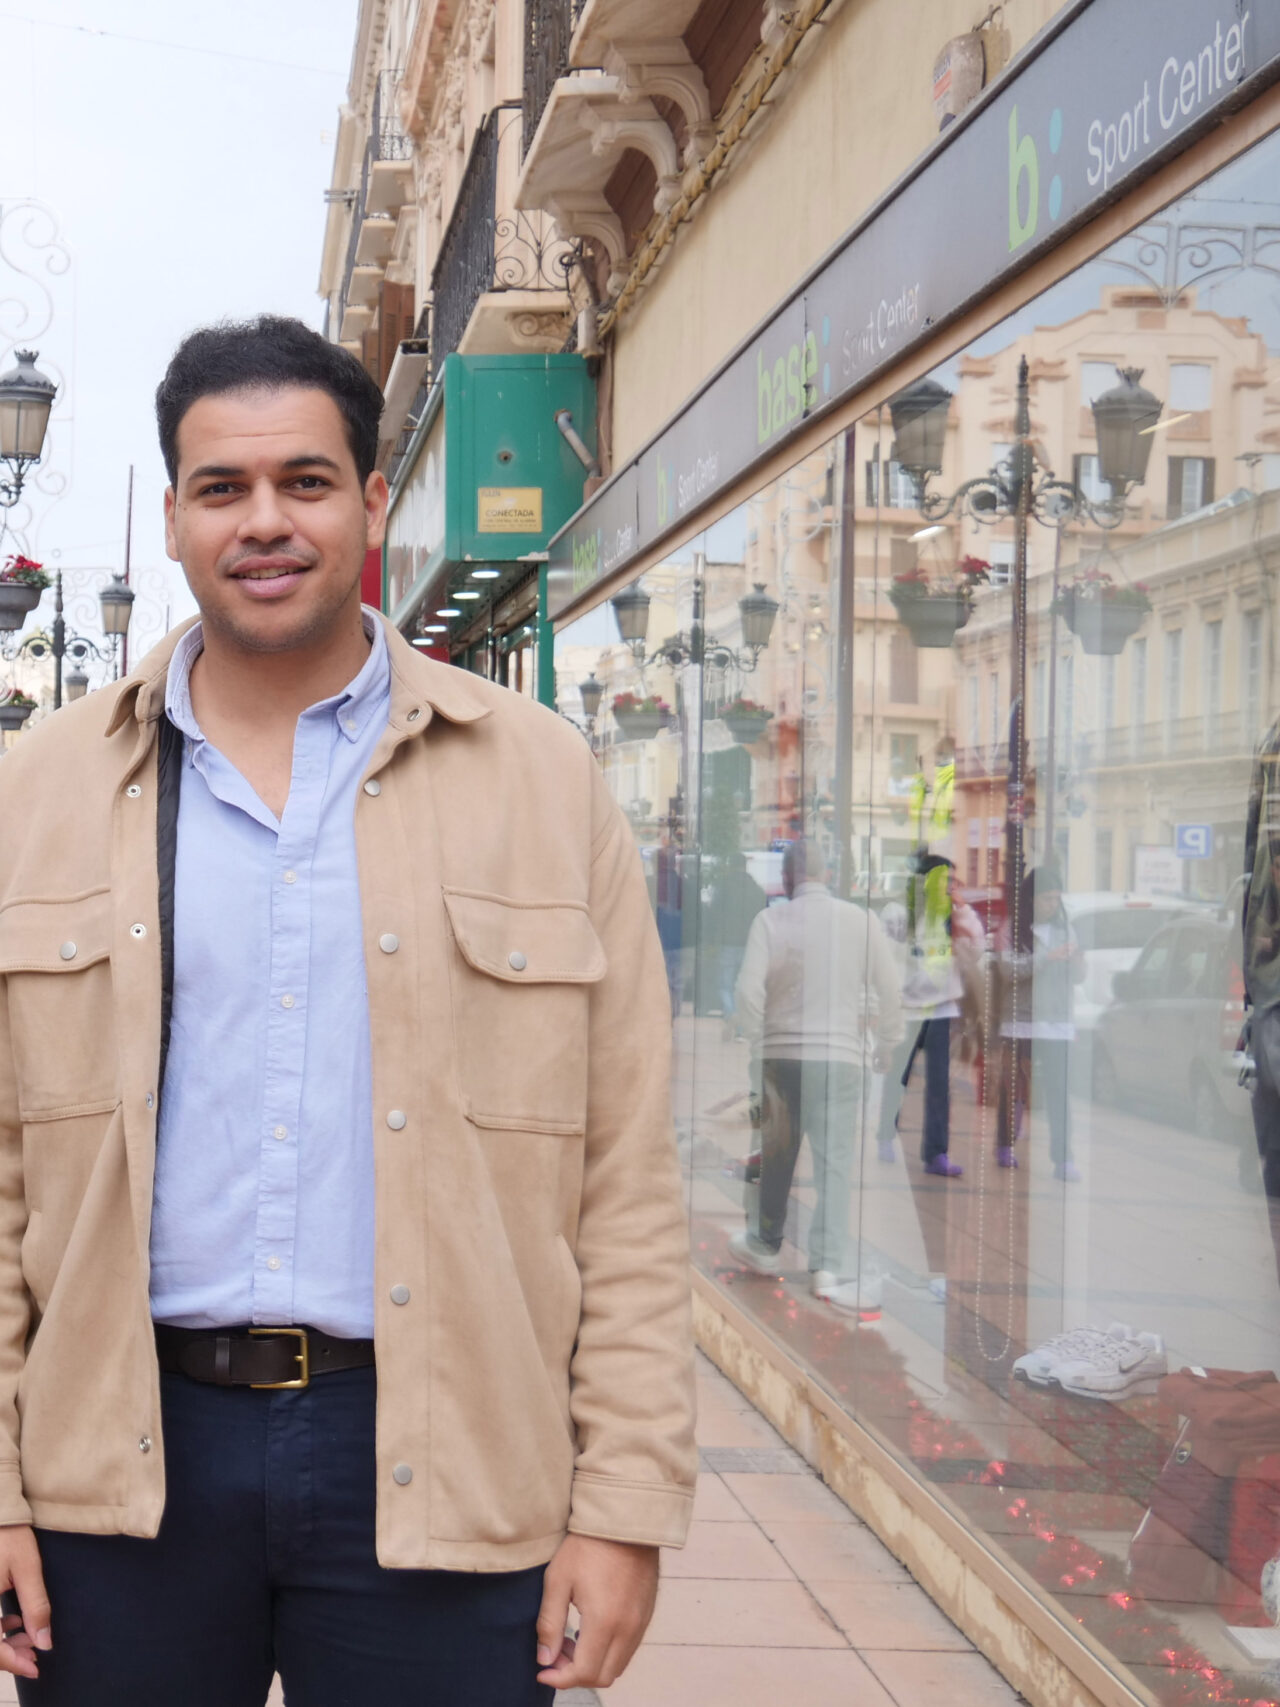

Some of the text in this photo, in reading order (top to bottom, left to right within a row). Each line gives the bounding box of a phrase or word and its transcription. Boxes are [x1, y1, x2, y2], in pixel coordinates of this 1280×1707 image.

[1086, 80, 1150, 190] Sport
[1158, 10, 1249, 130] Center
[877, 282, 920, 350] Center
[485, 508, 535, 518] CONECTADA
